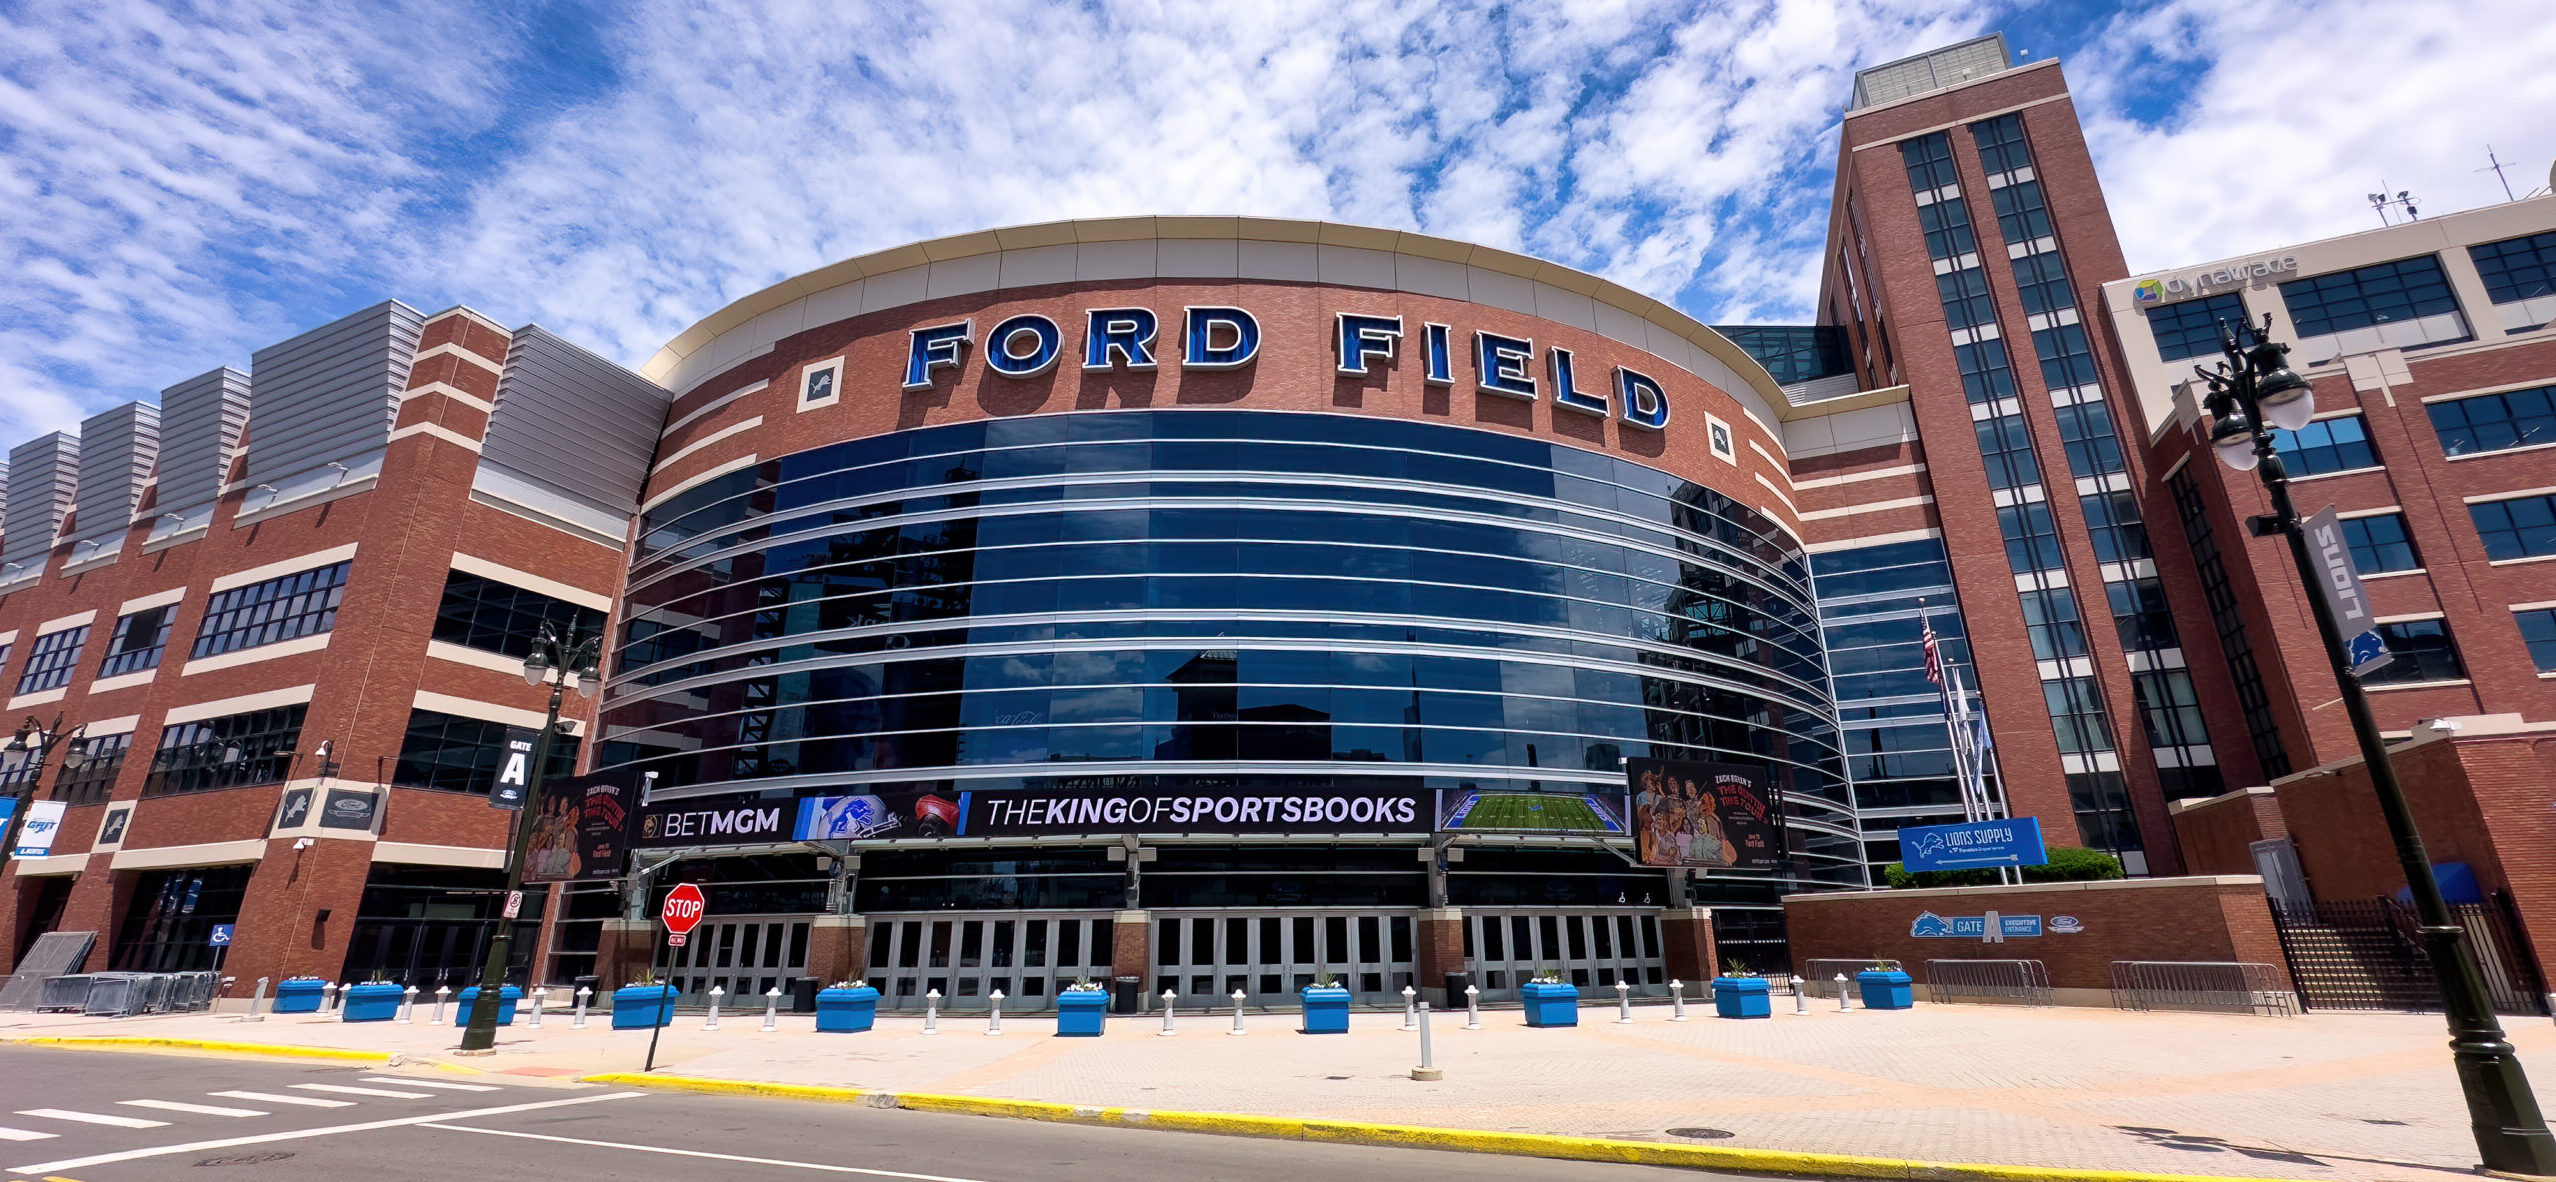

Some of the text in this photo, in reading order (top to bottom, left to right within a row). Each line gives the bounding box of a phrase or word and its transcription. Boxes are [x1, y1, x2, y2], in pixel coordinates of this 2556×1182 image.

[2166, 255, 2298, 296] dynatrace
[902, 306, 1671, 430] FORD FIELD
[2314, 524, 2365, 620] LIONS
[509, 740, 533, 752] GATE
[500, 752, 526, 786] A
[664, 808, 780, 837] BETMGM
[987, 796, 1416, 825] THEKINGOFSPORTSBOOKS
[1945, 828, 2013, 847] LIONS SUPPLY
[666, 898, 701, 918] STOP
[1957, 920, 1984, 933] GATE
[1982, 910, 2004, 943] A
